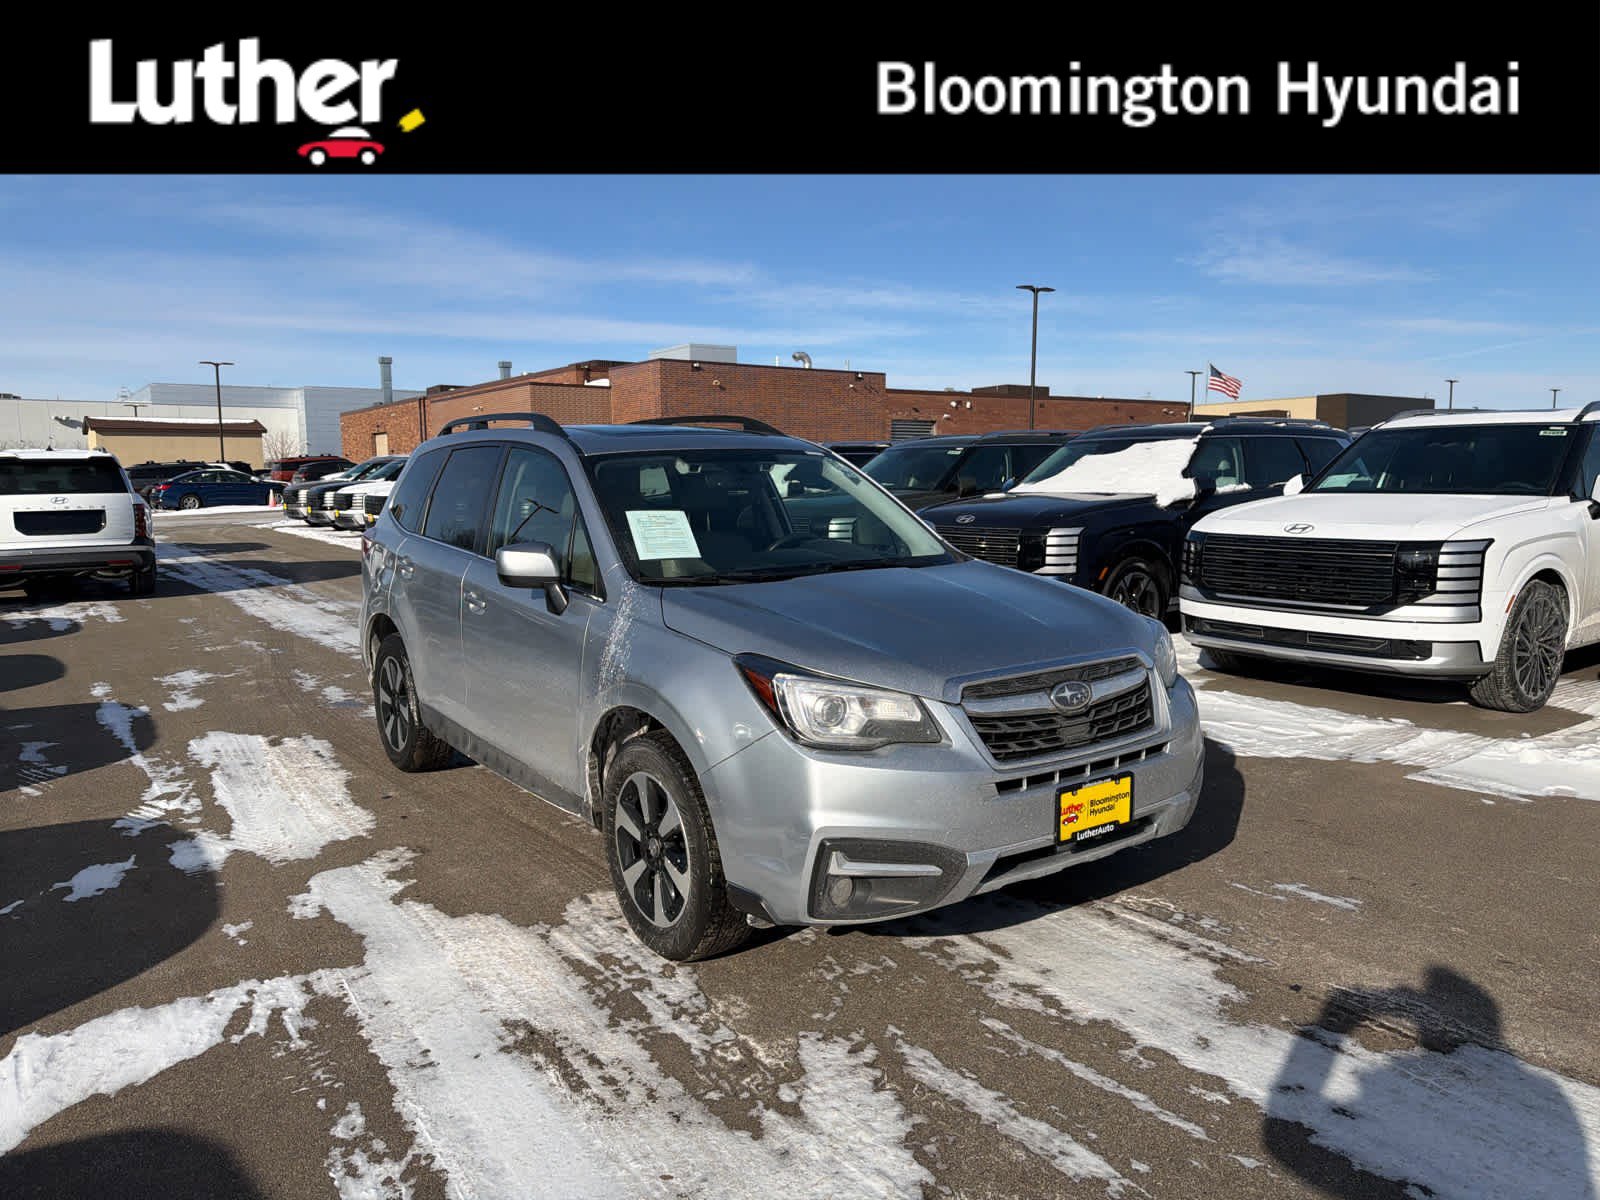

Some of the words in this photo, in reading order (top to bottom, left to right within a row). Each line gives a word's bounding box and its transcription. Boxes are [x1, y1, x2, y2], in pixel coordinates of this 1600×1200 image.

[1090, 792, 1130, 807] Bloomington
[1061, 802, 1084, 816] Luther
[1090, 804, 1115, 816] Hyundai
[1076, 824, 1115, 841] LutherAuto
